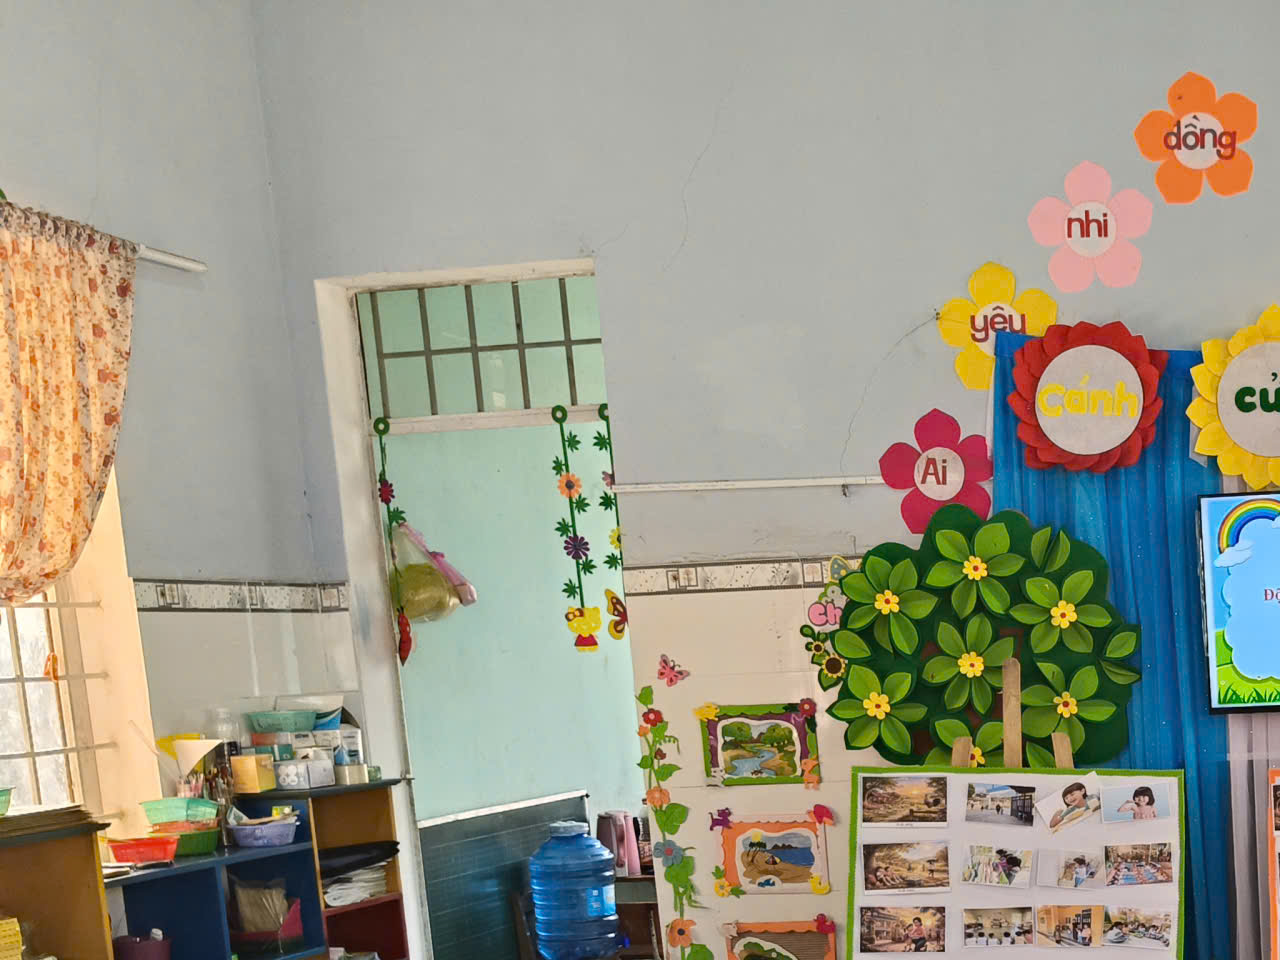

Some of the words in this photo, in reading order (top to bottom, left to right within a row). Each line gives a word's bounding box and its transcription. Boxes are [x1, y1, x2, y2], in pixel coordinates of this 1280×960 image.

[920, 457, 948, 486] Ai
[970, 306, 1027, 343] yêu
[1067, 210, 1109, 239] nhi
[1037, 374, 1139, 418] Cánh
